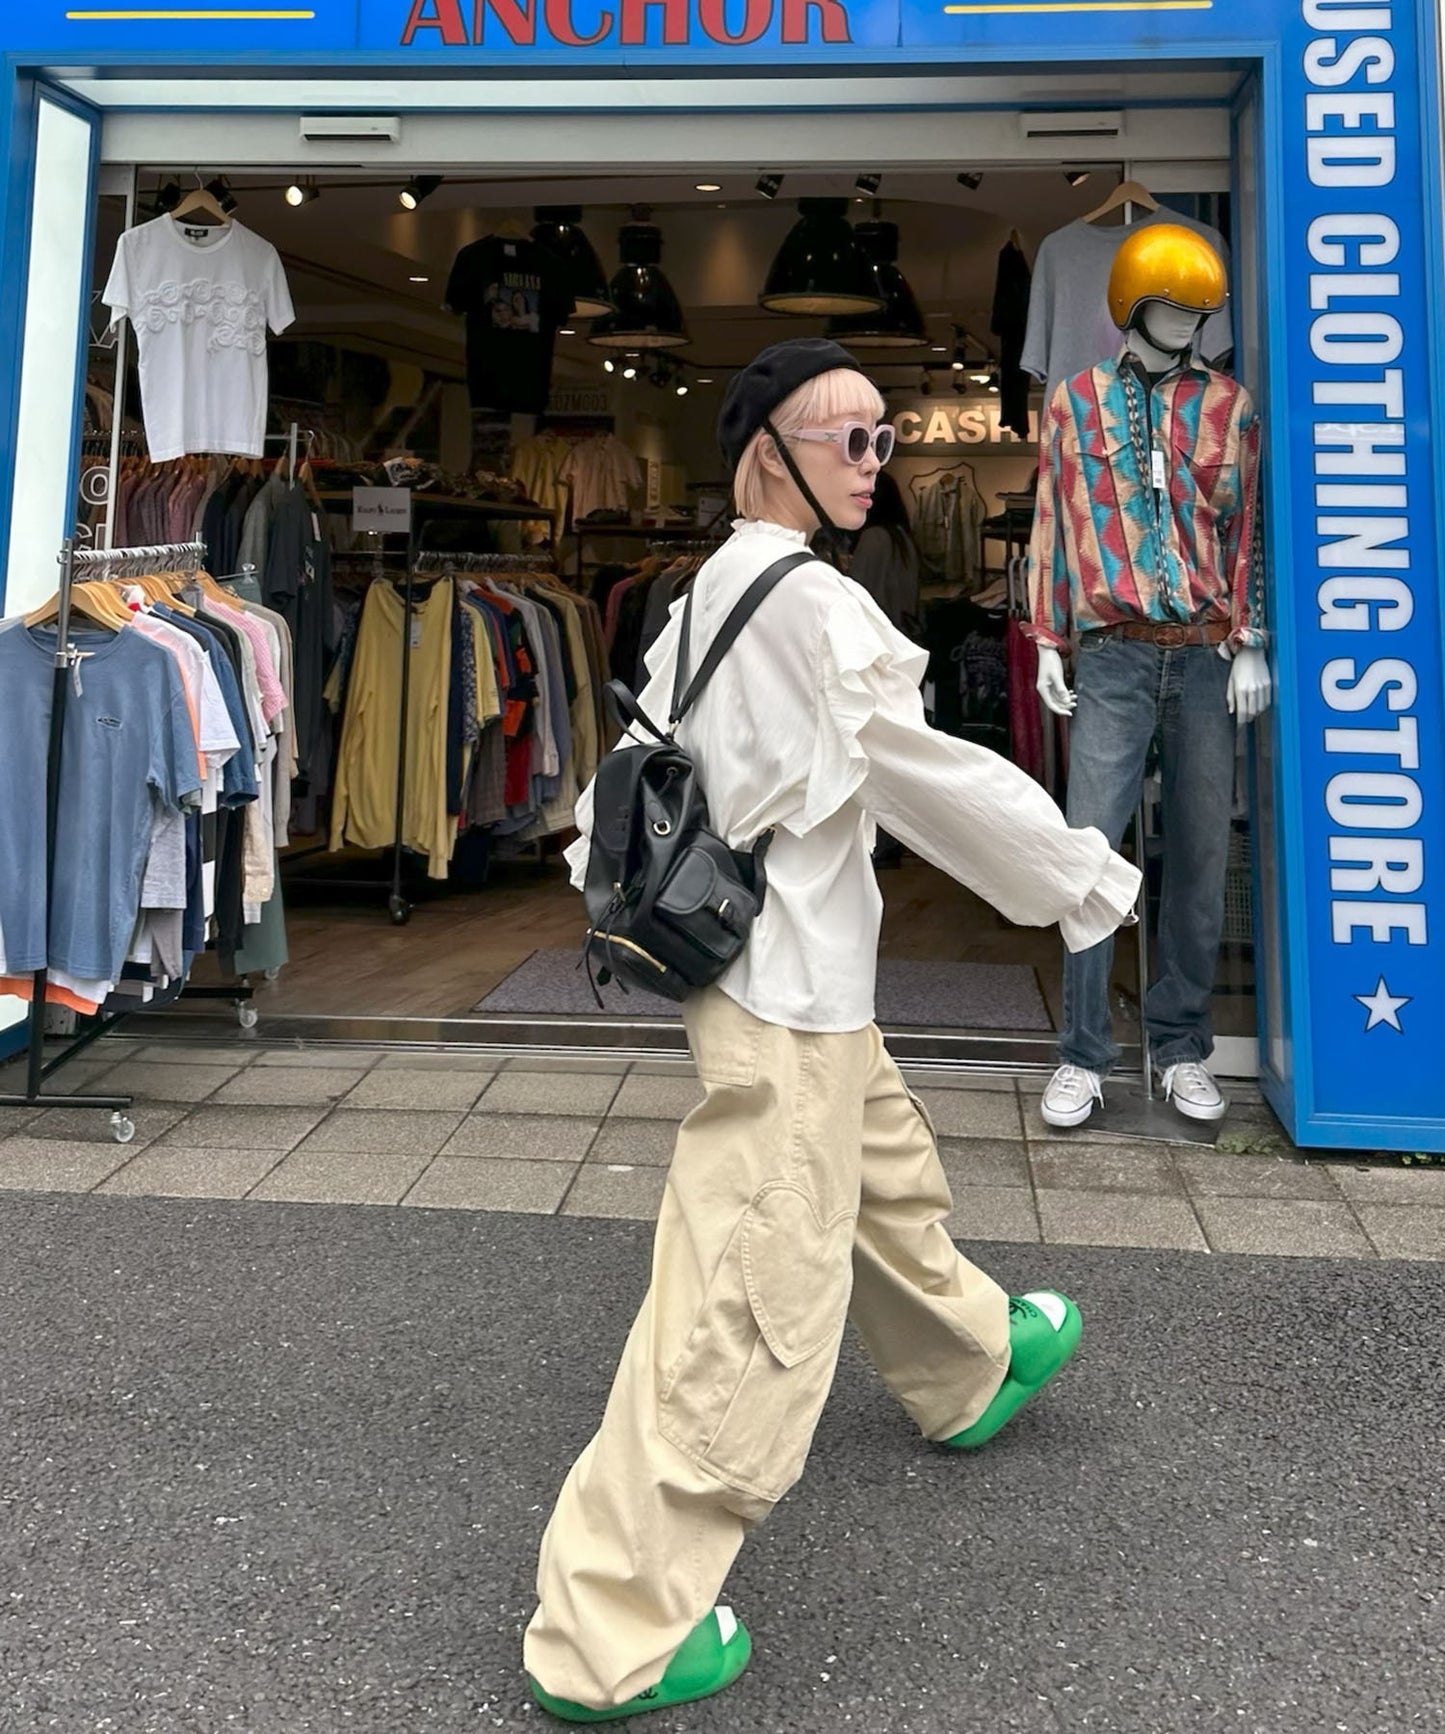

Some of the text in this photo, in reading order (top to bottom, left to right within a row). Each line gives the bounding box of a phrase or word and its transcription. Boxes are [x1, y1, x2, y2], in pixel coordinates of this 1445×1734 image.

[1300, 0, 1397, 188] USED
[1305, 212, 1415, 632] CLOTHING
[1318, 656, 1429, 946] STORE
